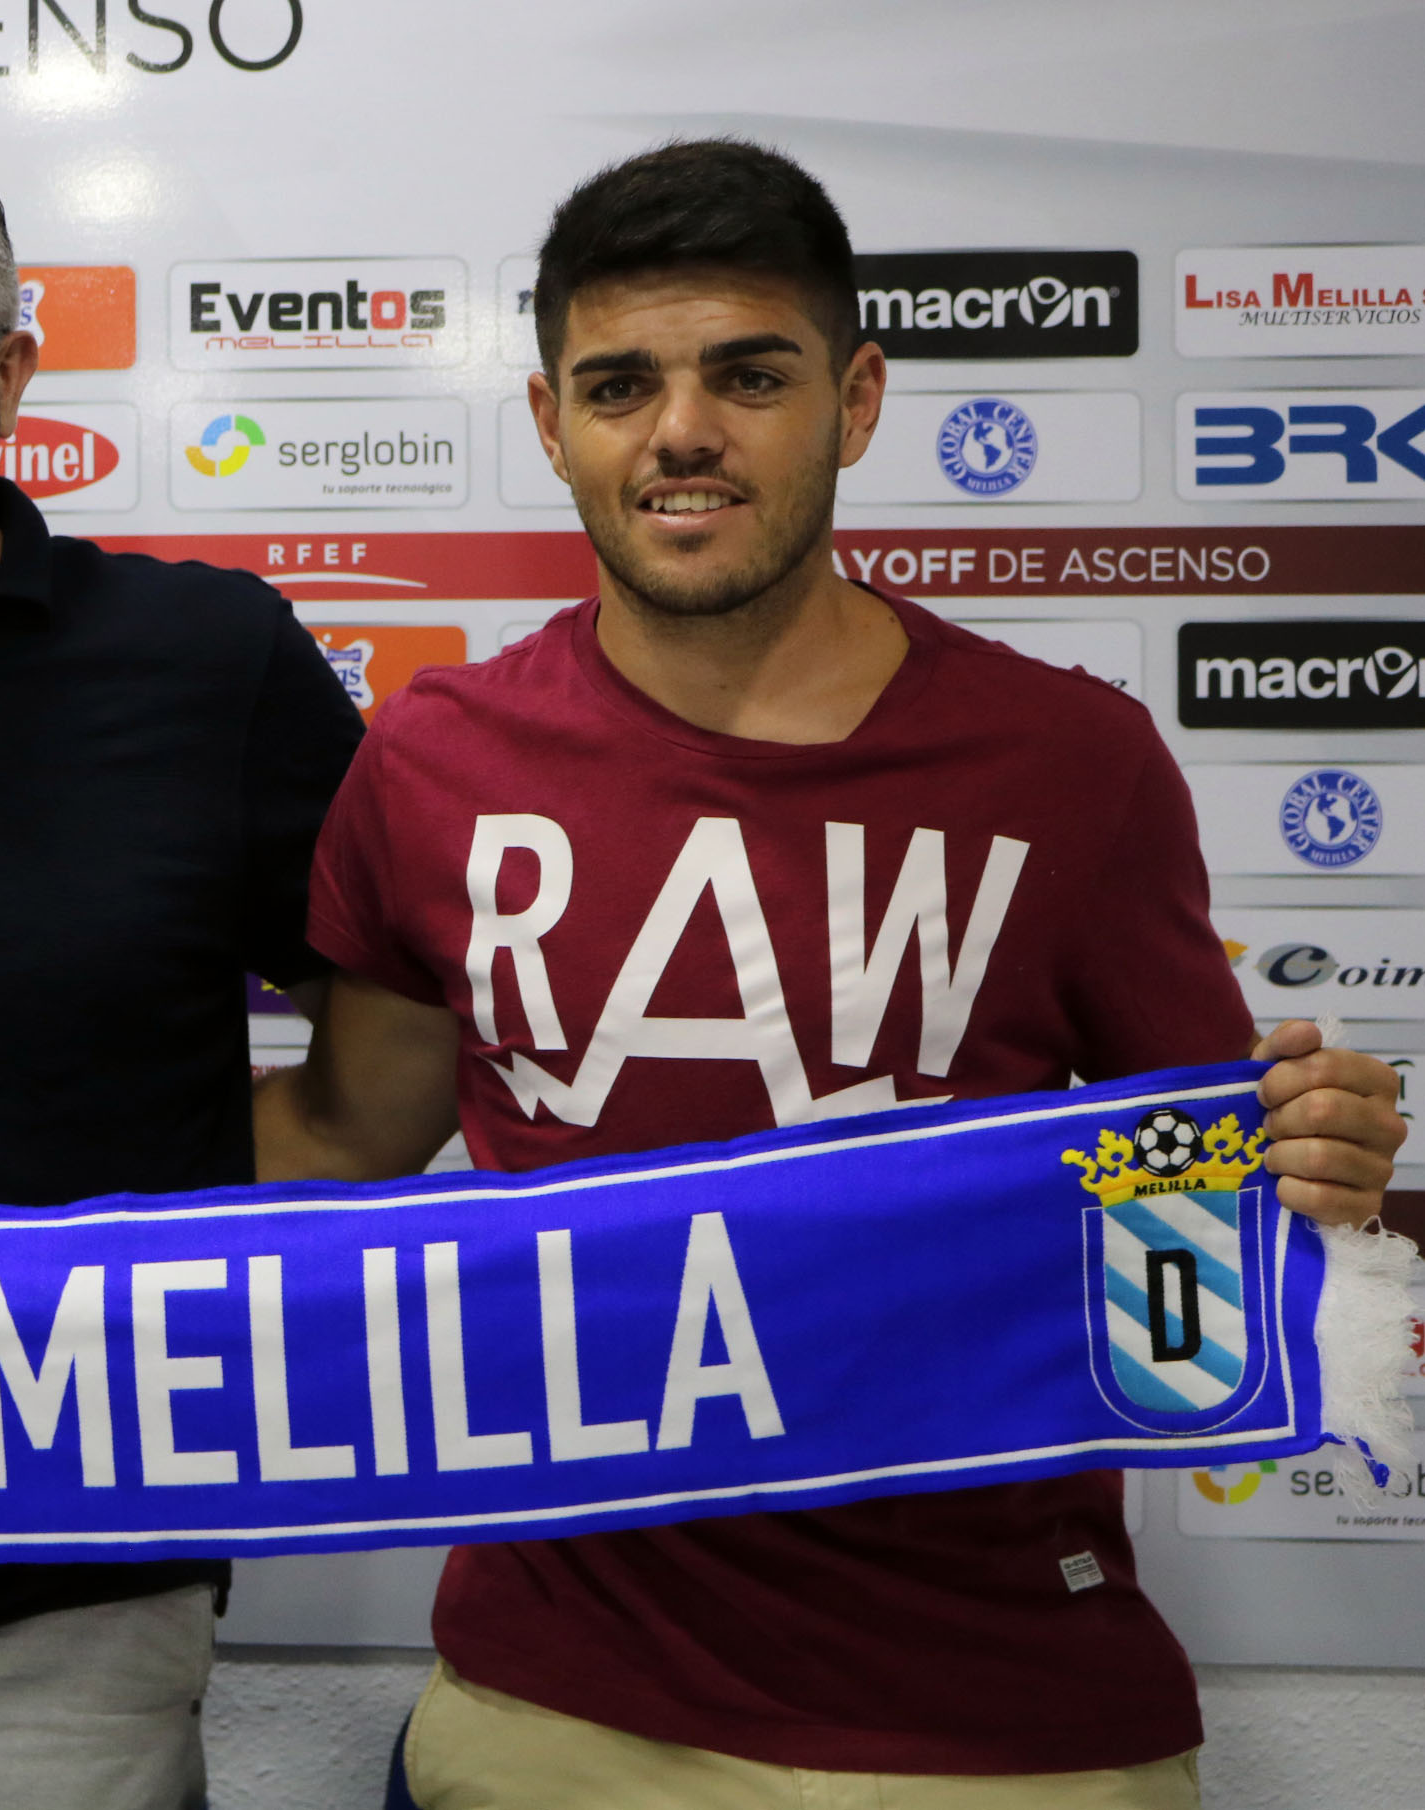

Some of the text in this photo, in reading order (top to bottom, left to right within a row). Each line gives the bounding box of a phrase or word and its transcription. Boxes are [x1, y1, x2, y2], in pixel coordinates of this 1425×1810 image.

[189, 279, 446, 334] Eventos
[857, 276, 1111, 330] macron
[1272, 272, 1414, 308] MELILLA
[1238, 308, 1422, 327] MULTISERVICIOS
[278, 430, 454, 478] serglobin
[338, 484, 382, 496] soporte
[267, 543, 368, 566] RFEF
[988, 548, 1046, 583] DE
[1059, 546, 1272, 584] ASCENSO
[1195, 646, 1425, 699] macro
[464, 813, 1032, 1128] RAW
[1133, 1177, 1207, 1198] MELILLA
[1145, 1249, 1202, 1363] D
